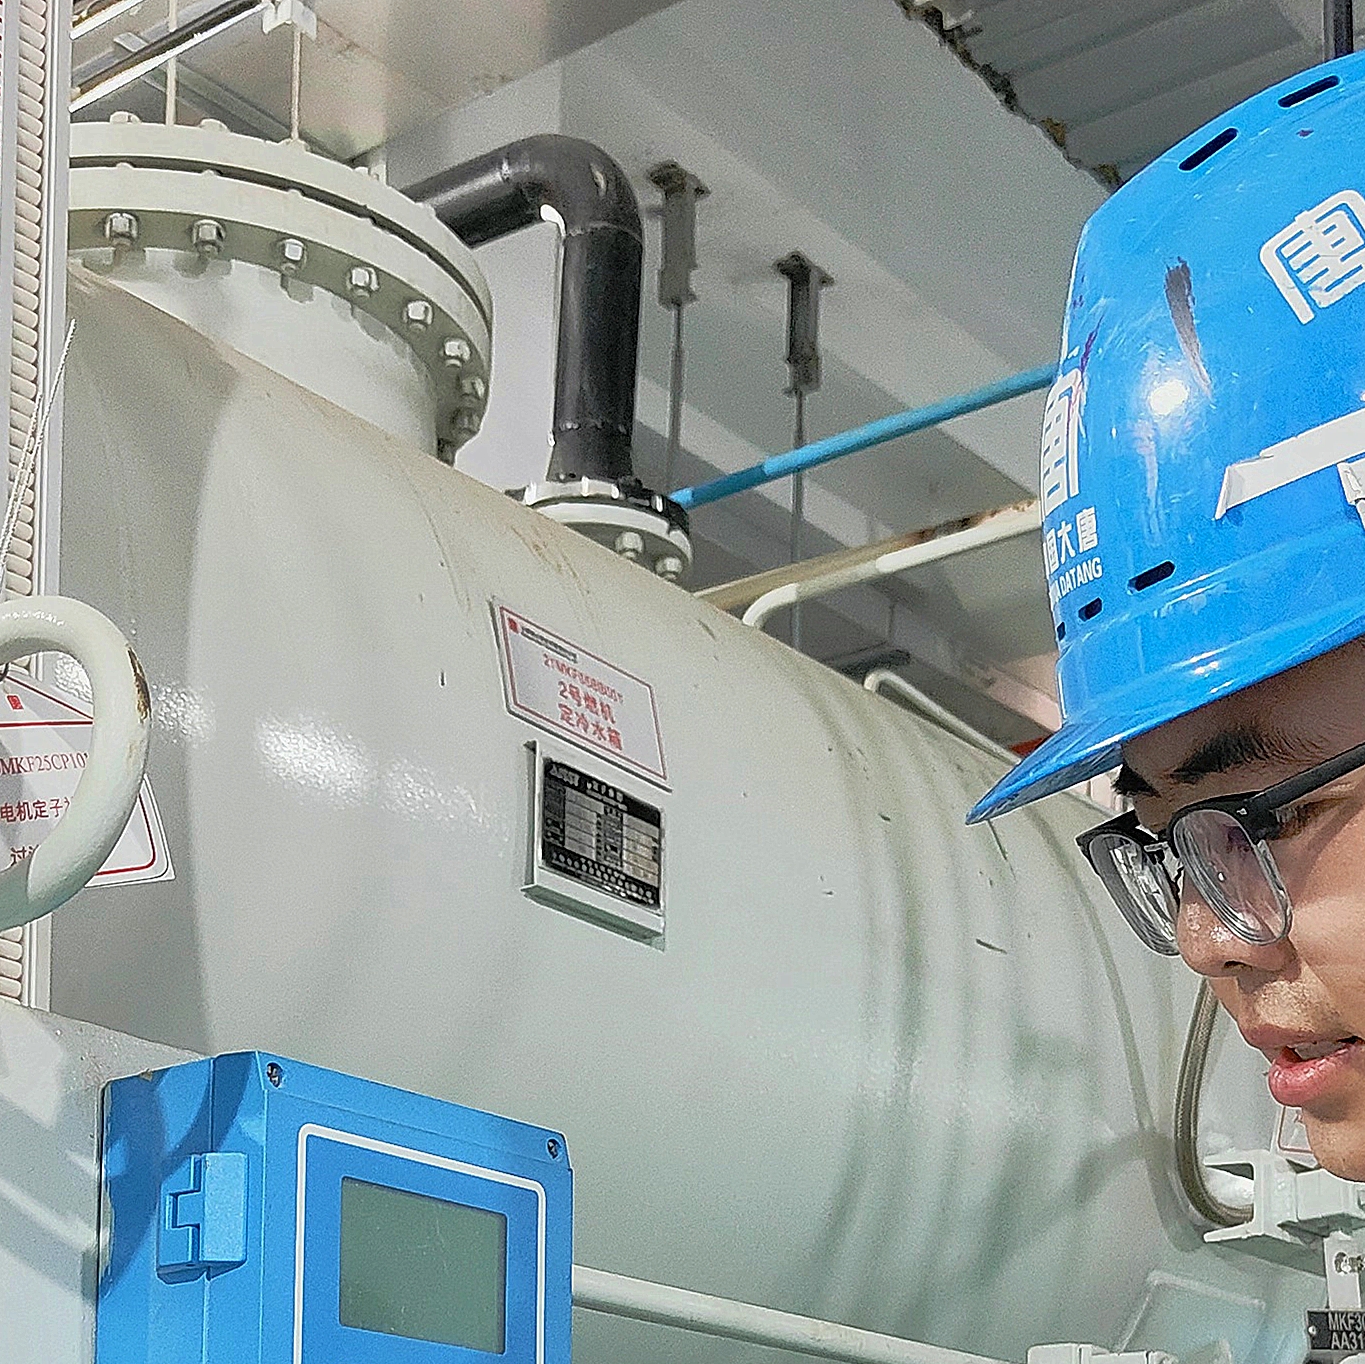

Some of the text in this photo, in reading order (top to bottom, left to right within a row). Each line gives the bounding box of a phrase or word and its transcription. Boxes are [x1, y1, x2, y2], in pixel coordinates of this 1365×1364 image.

[1043, 506, 1099, 579] 国大唐
[1059, 557, 1103, 597] DATANG
